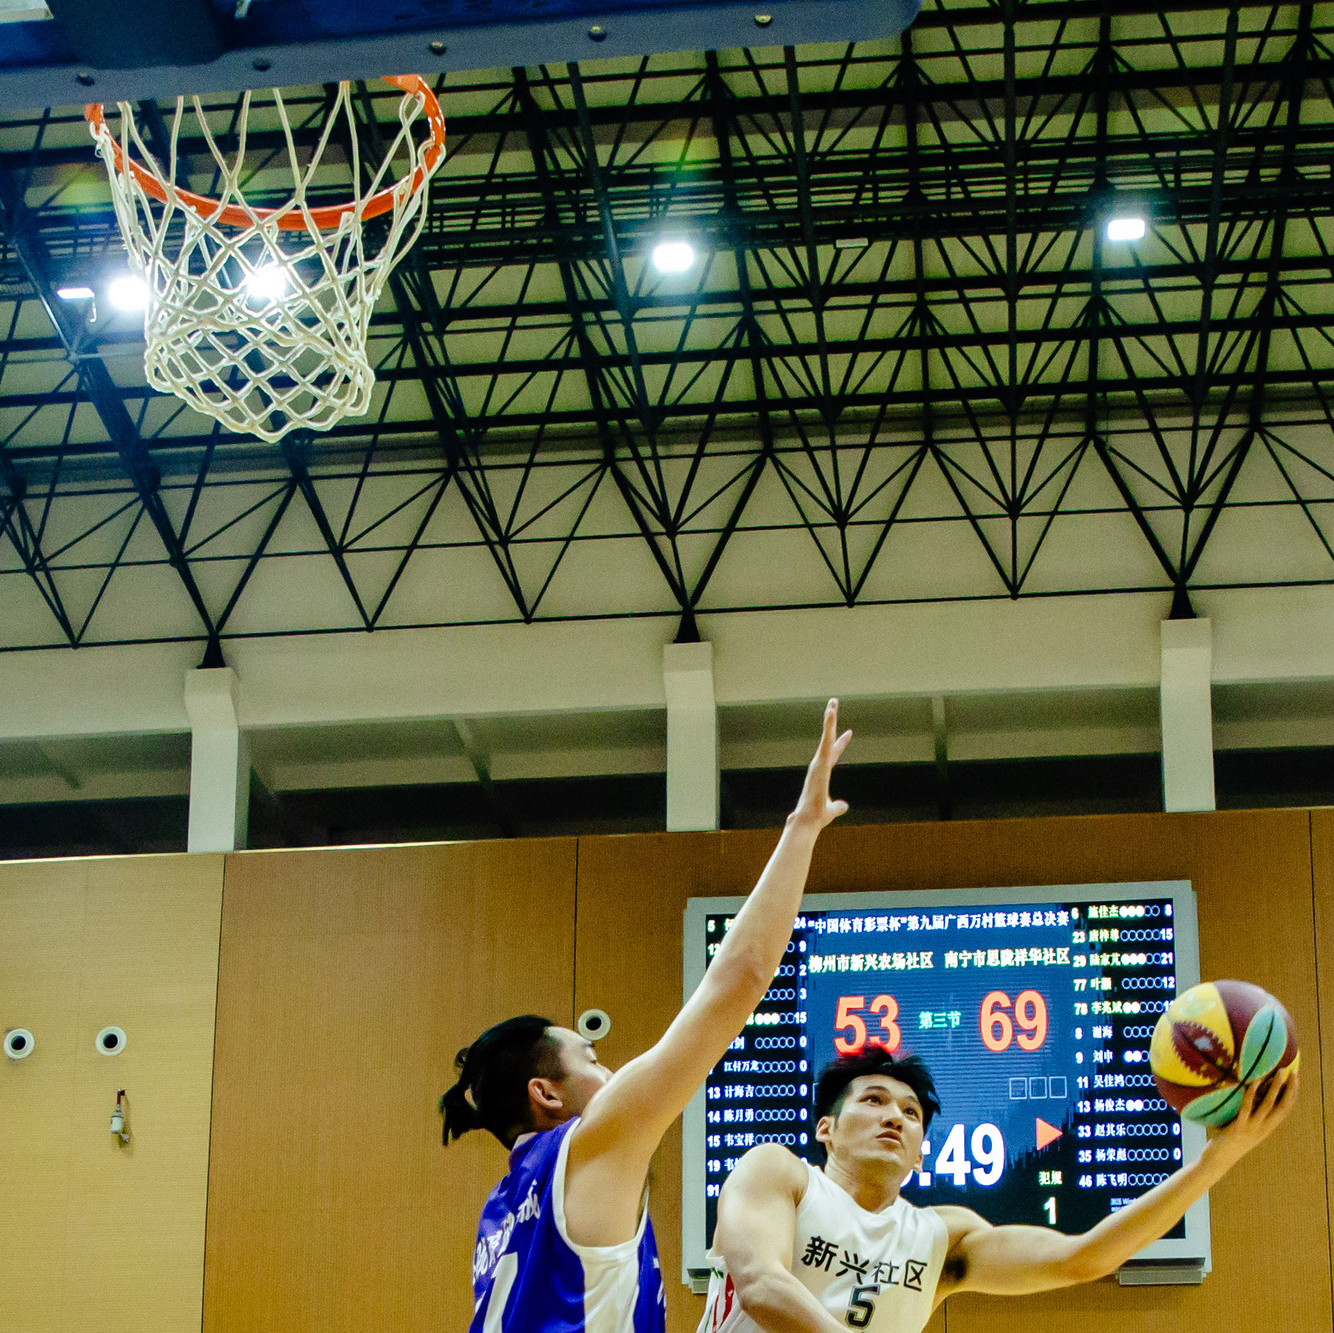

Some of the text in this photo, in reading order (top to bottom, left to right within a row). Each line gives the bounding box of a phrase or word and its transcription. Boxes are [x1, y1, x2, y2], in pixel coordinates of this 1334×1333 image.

[1073, 931, 1086, 943] 23
[1161, 928, 1173, 940] 15
[808, 951, 934, 973] 柳州市新兴农场社区
[1161, 953, 1173, 964] 21
[799, 964, 807, 976] 2
[1073, 979, 1087, 991] 77
[1162, 977, 1175, 988] 12
[799, 988, 807, 999] 3
[1074, 1003, 1087, 1015] 78
[794, 1012, 807, 1023] 15
[919, 1011, 961, 1029] 第三节
[980, 990, 1047, 1051] 69
[834, 995, 901, 1056] 53
[1076, 1052, 1083, 1063] 9
[1077, 1076, 1088, 1088] 11
[708, 1087, 720, 1098] 13
[1078, 1101, 1090, 1112] 13
[708, 1111, 720, 1121] 14
[1078, 1126, 1091, 1137] 33
[708, 1135, 720, 1146] 15
[900, 1123, 1004, 1186] :49
[1078, 1150, 1091, 1162] 35
[708, 1160, 720, 1171] 19
[1039, 1171, 1063, 1185] 犯规
[1079, 1175, 1092, 1187] 46
[707, 1184, 719, 1196] 91
[1044, 1197, 1056, 1224] 1
[801, 1236, 927, 1291] 新兴社区
[845, 1284, 880, 1329] 5
